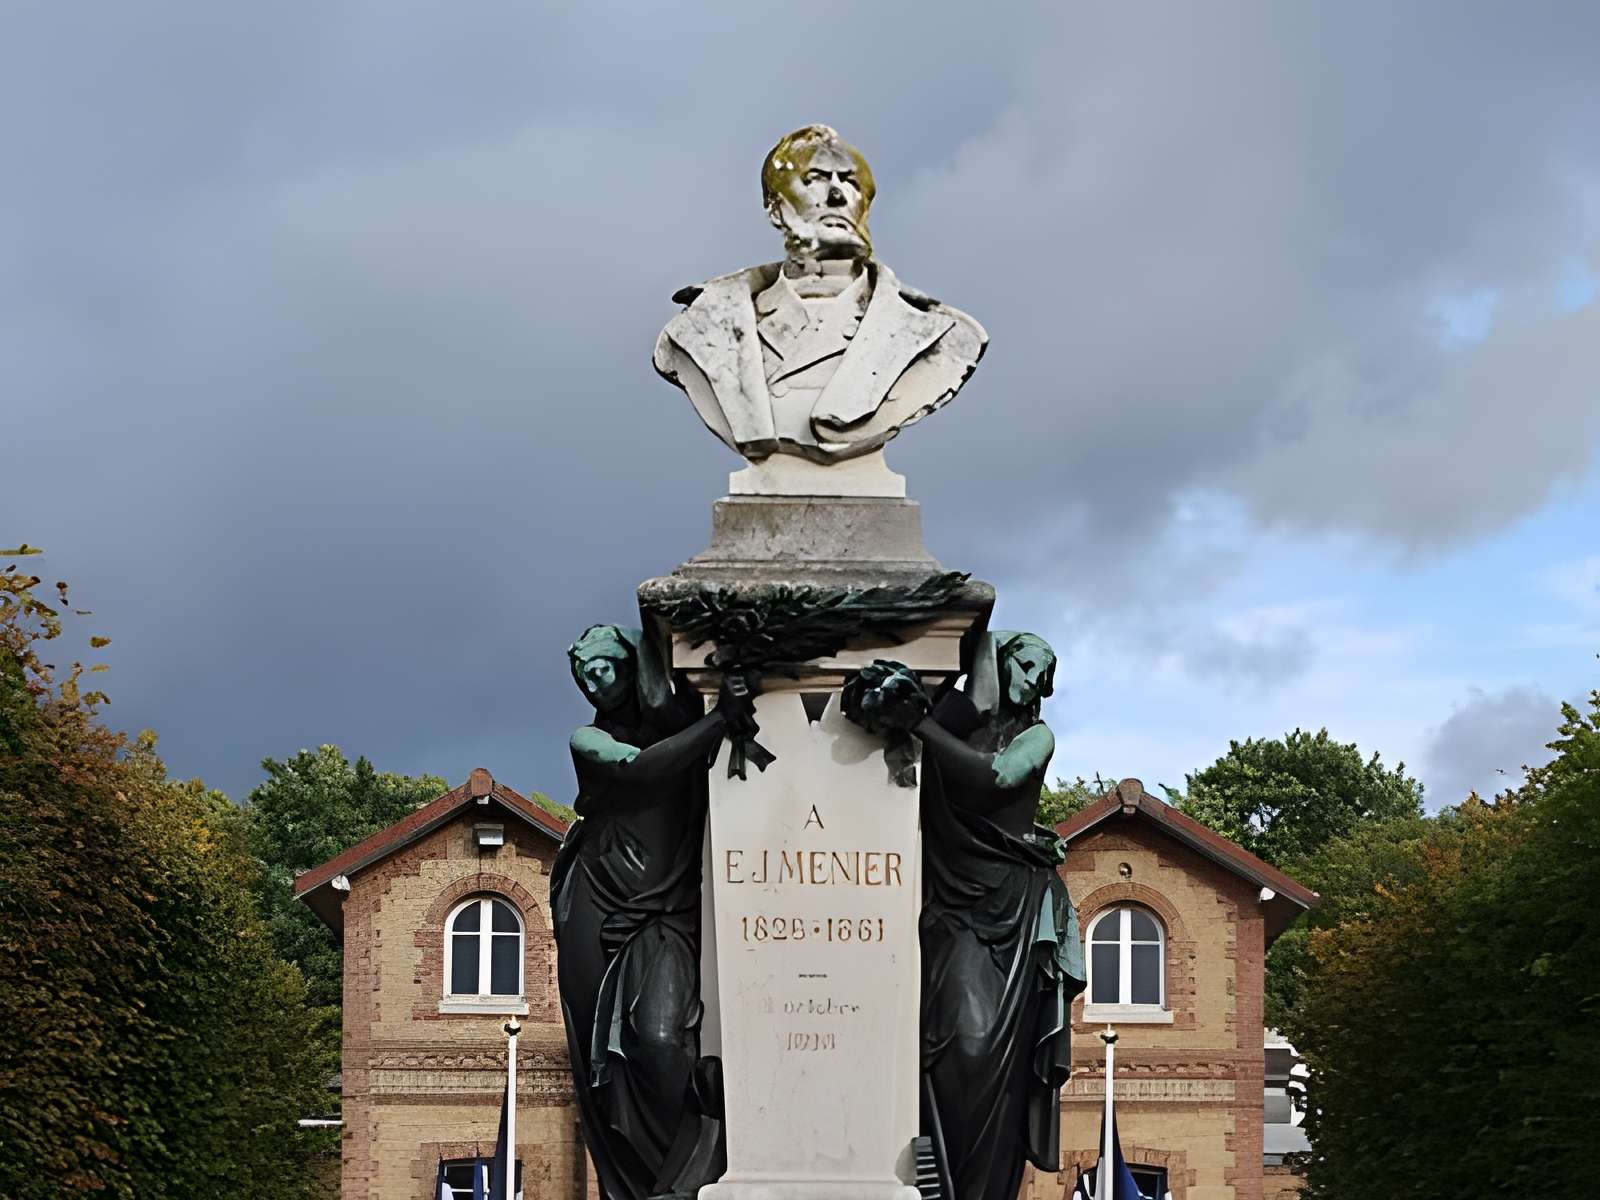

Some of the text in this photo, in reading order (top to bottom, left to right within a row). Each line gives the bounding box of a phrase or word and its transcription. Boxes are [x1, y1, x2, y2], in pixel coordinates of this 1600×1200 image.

[803, 803, 825, 830] A
[726, 850, 903, 887] E J MENIER
